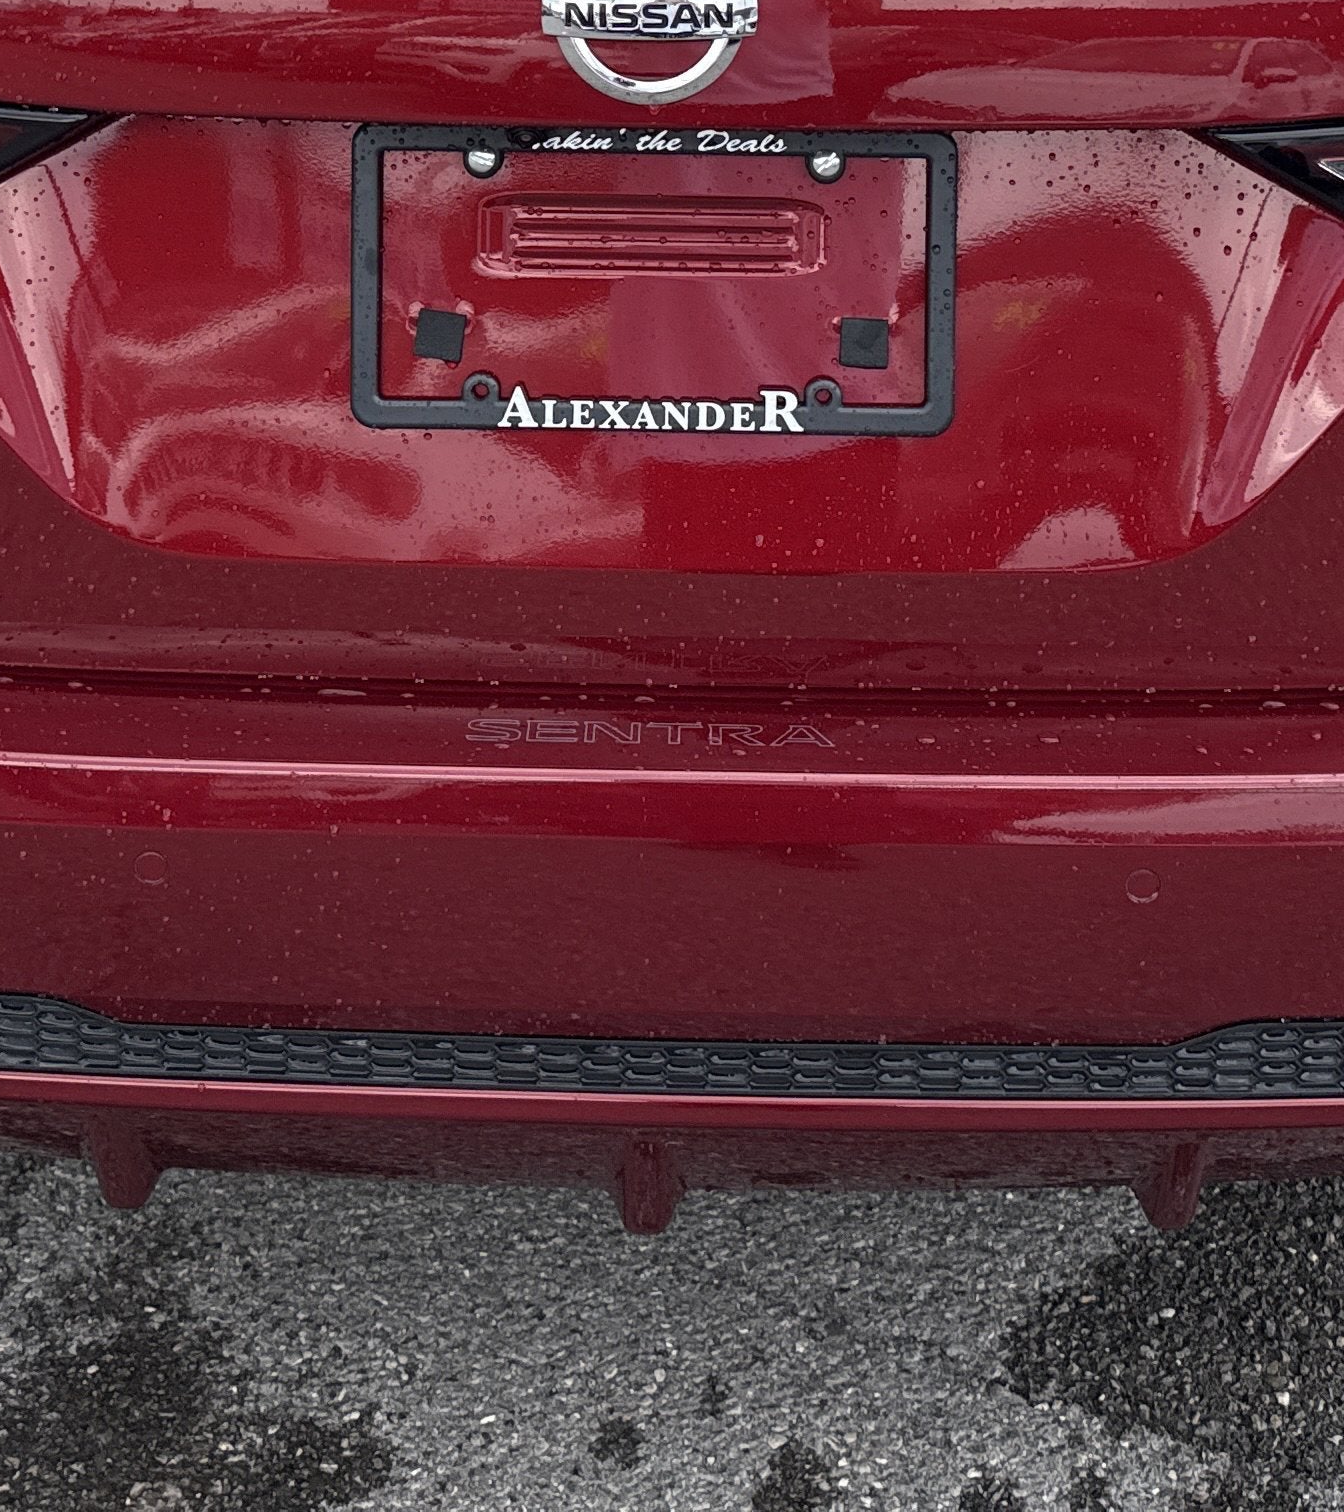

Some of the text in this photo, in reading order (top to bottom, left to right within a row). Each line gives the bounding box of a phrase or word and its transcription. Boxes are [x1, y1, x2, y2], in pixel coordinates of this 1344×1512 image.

[564, 2, 733, 29] NISSAN
[532, 127, 788, 153] akin' the Deals
[466, 718, 835, 748] SENTRA
